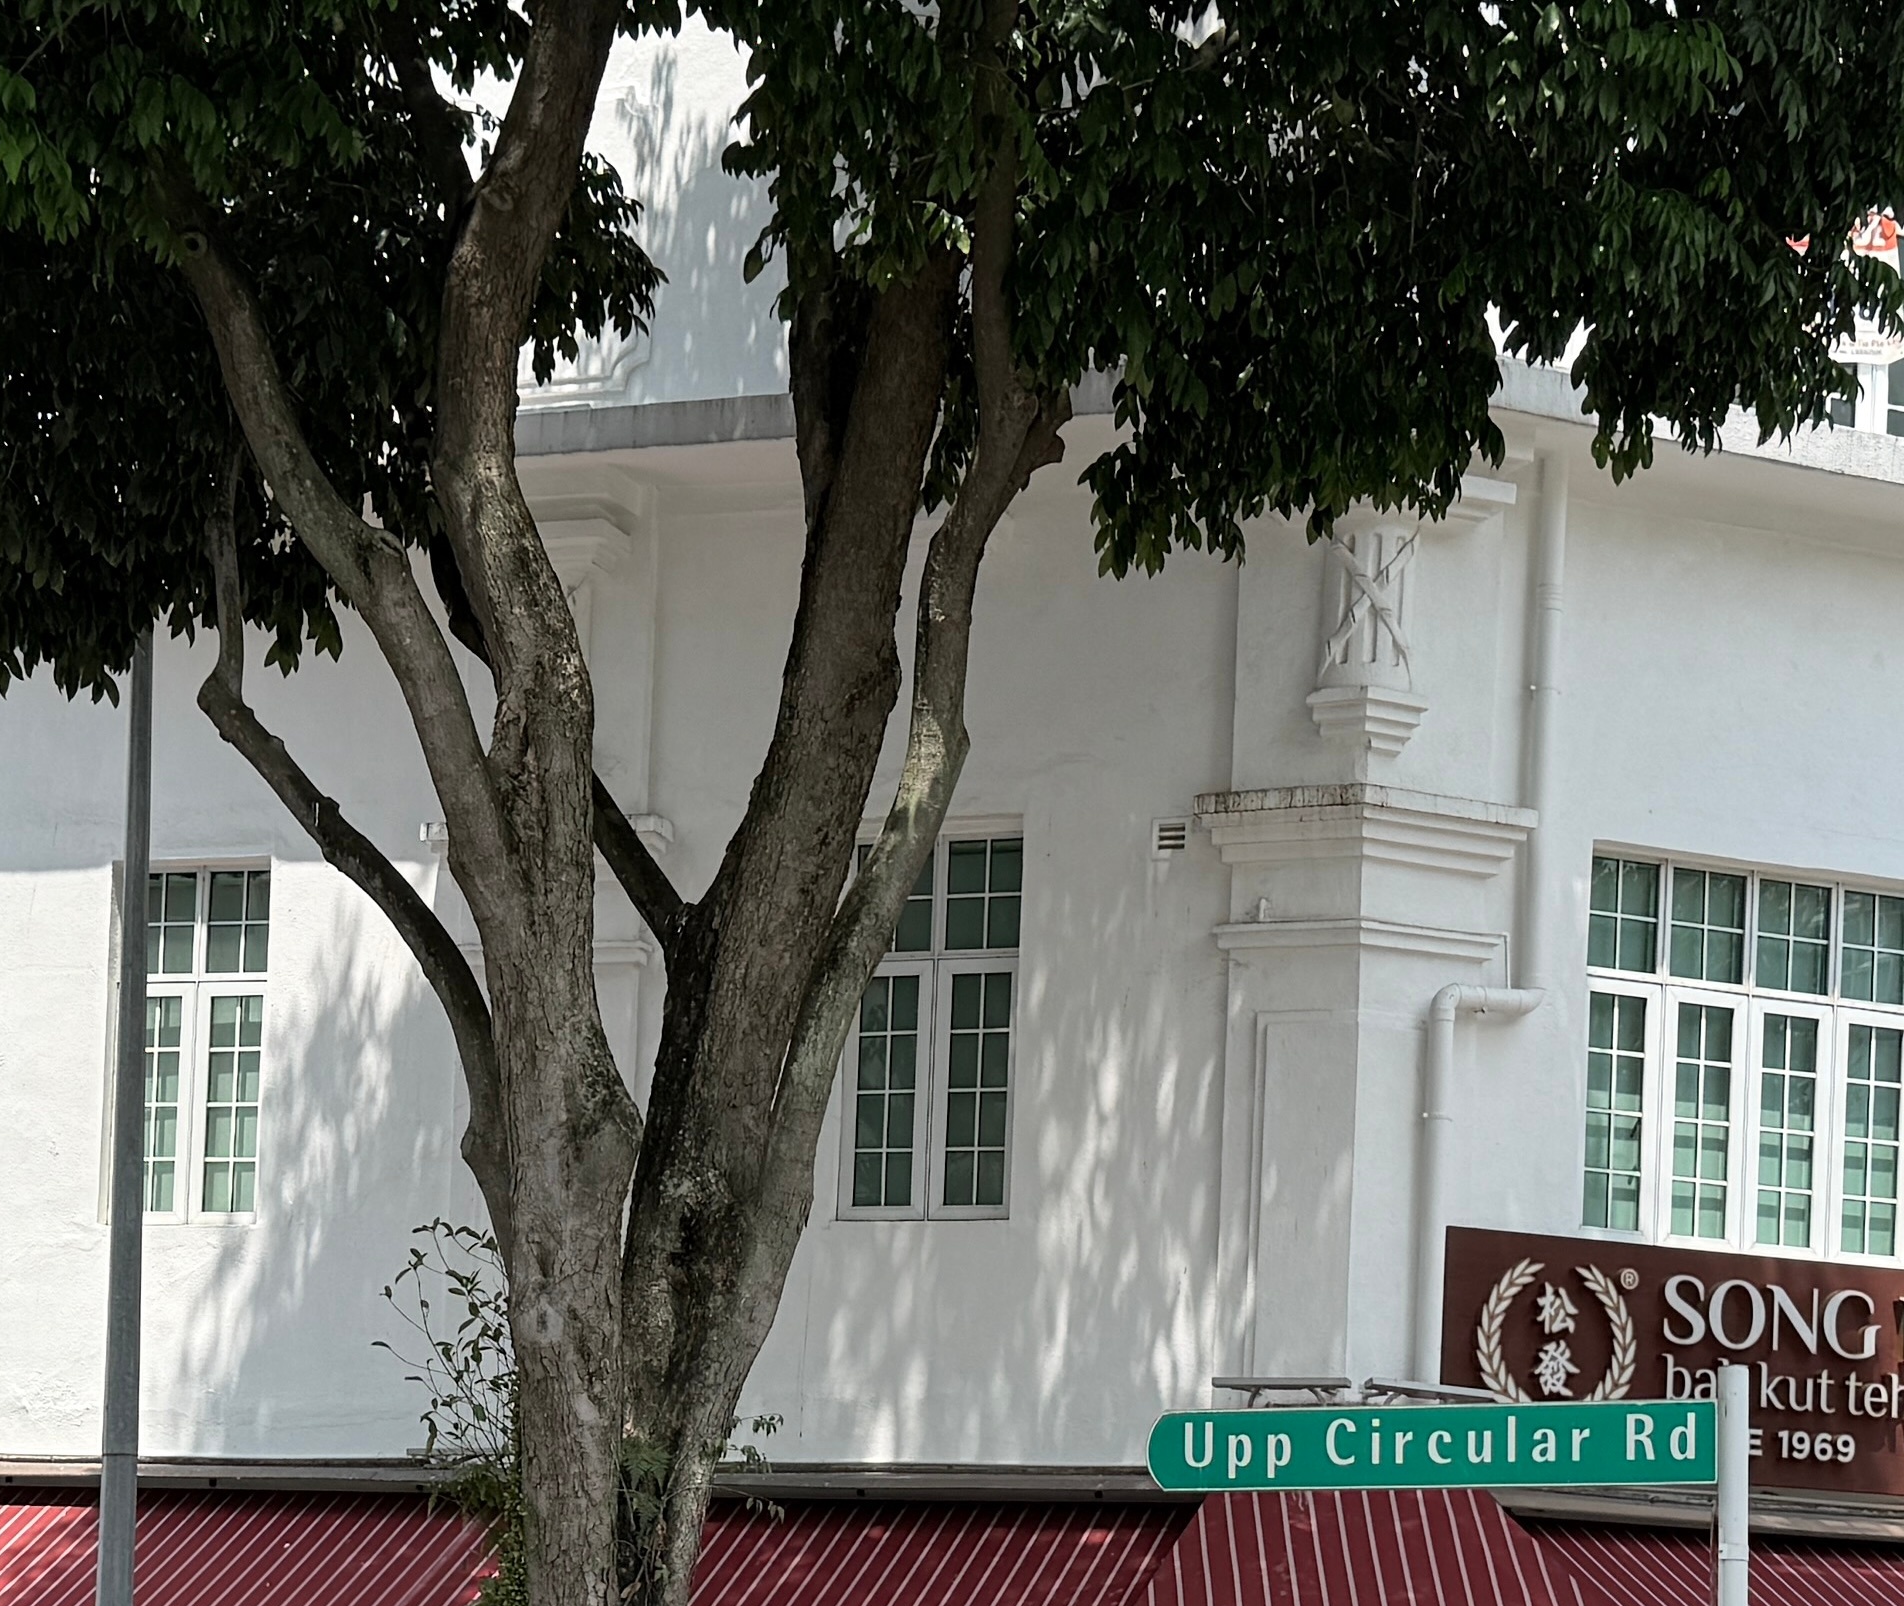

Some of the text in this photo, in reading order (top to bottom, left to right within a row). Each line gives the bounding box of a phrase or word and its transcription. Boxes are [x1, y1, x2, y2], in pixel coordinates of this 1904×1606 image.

[1534, 1281, 1581, 1397] 松發
[1663, 1274, 1882, 1361] SONG
[1661, 1353, 1730, 1400] ba
[1757, 1360, 1836, 1415] kut
[1183, 1420, 1292, 1479] Upp
[1325, 1414, 1591, 1467] Circular
[1626, 1411, 1696, 1462] Rd
[1778, 1429, 1856, 1463] 1969
